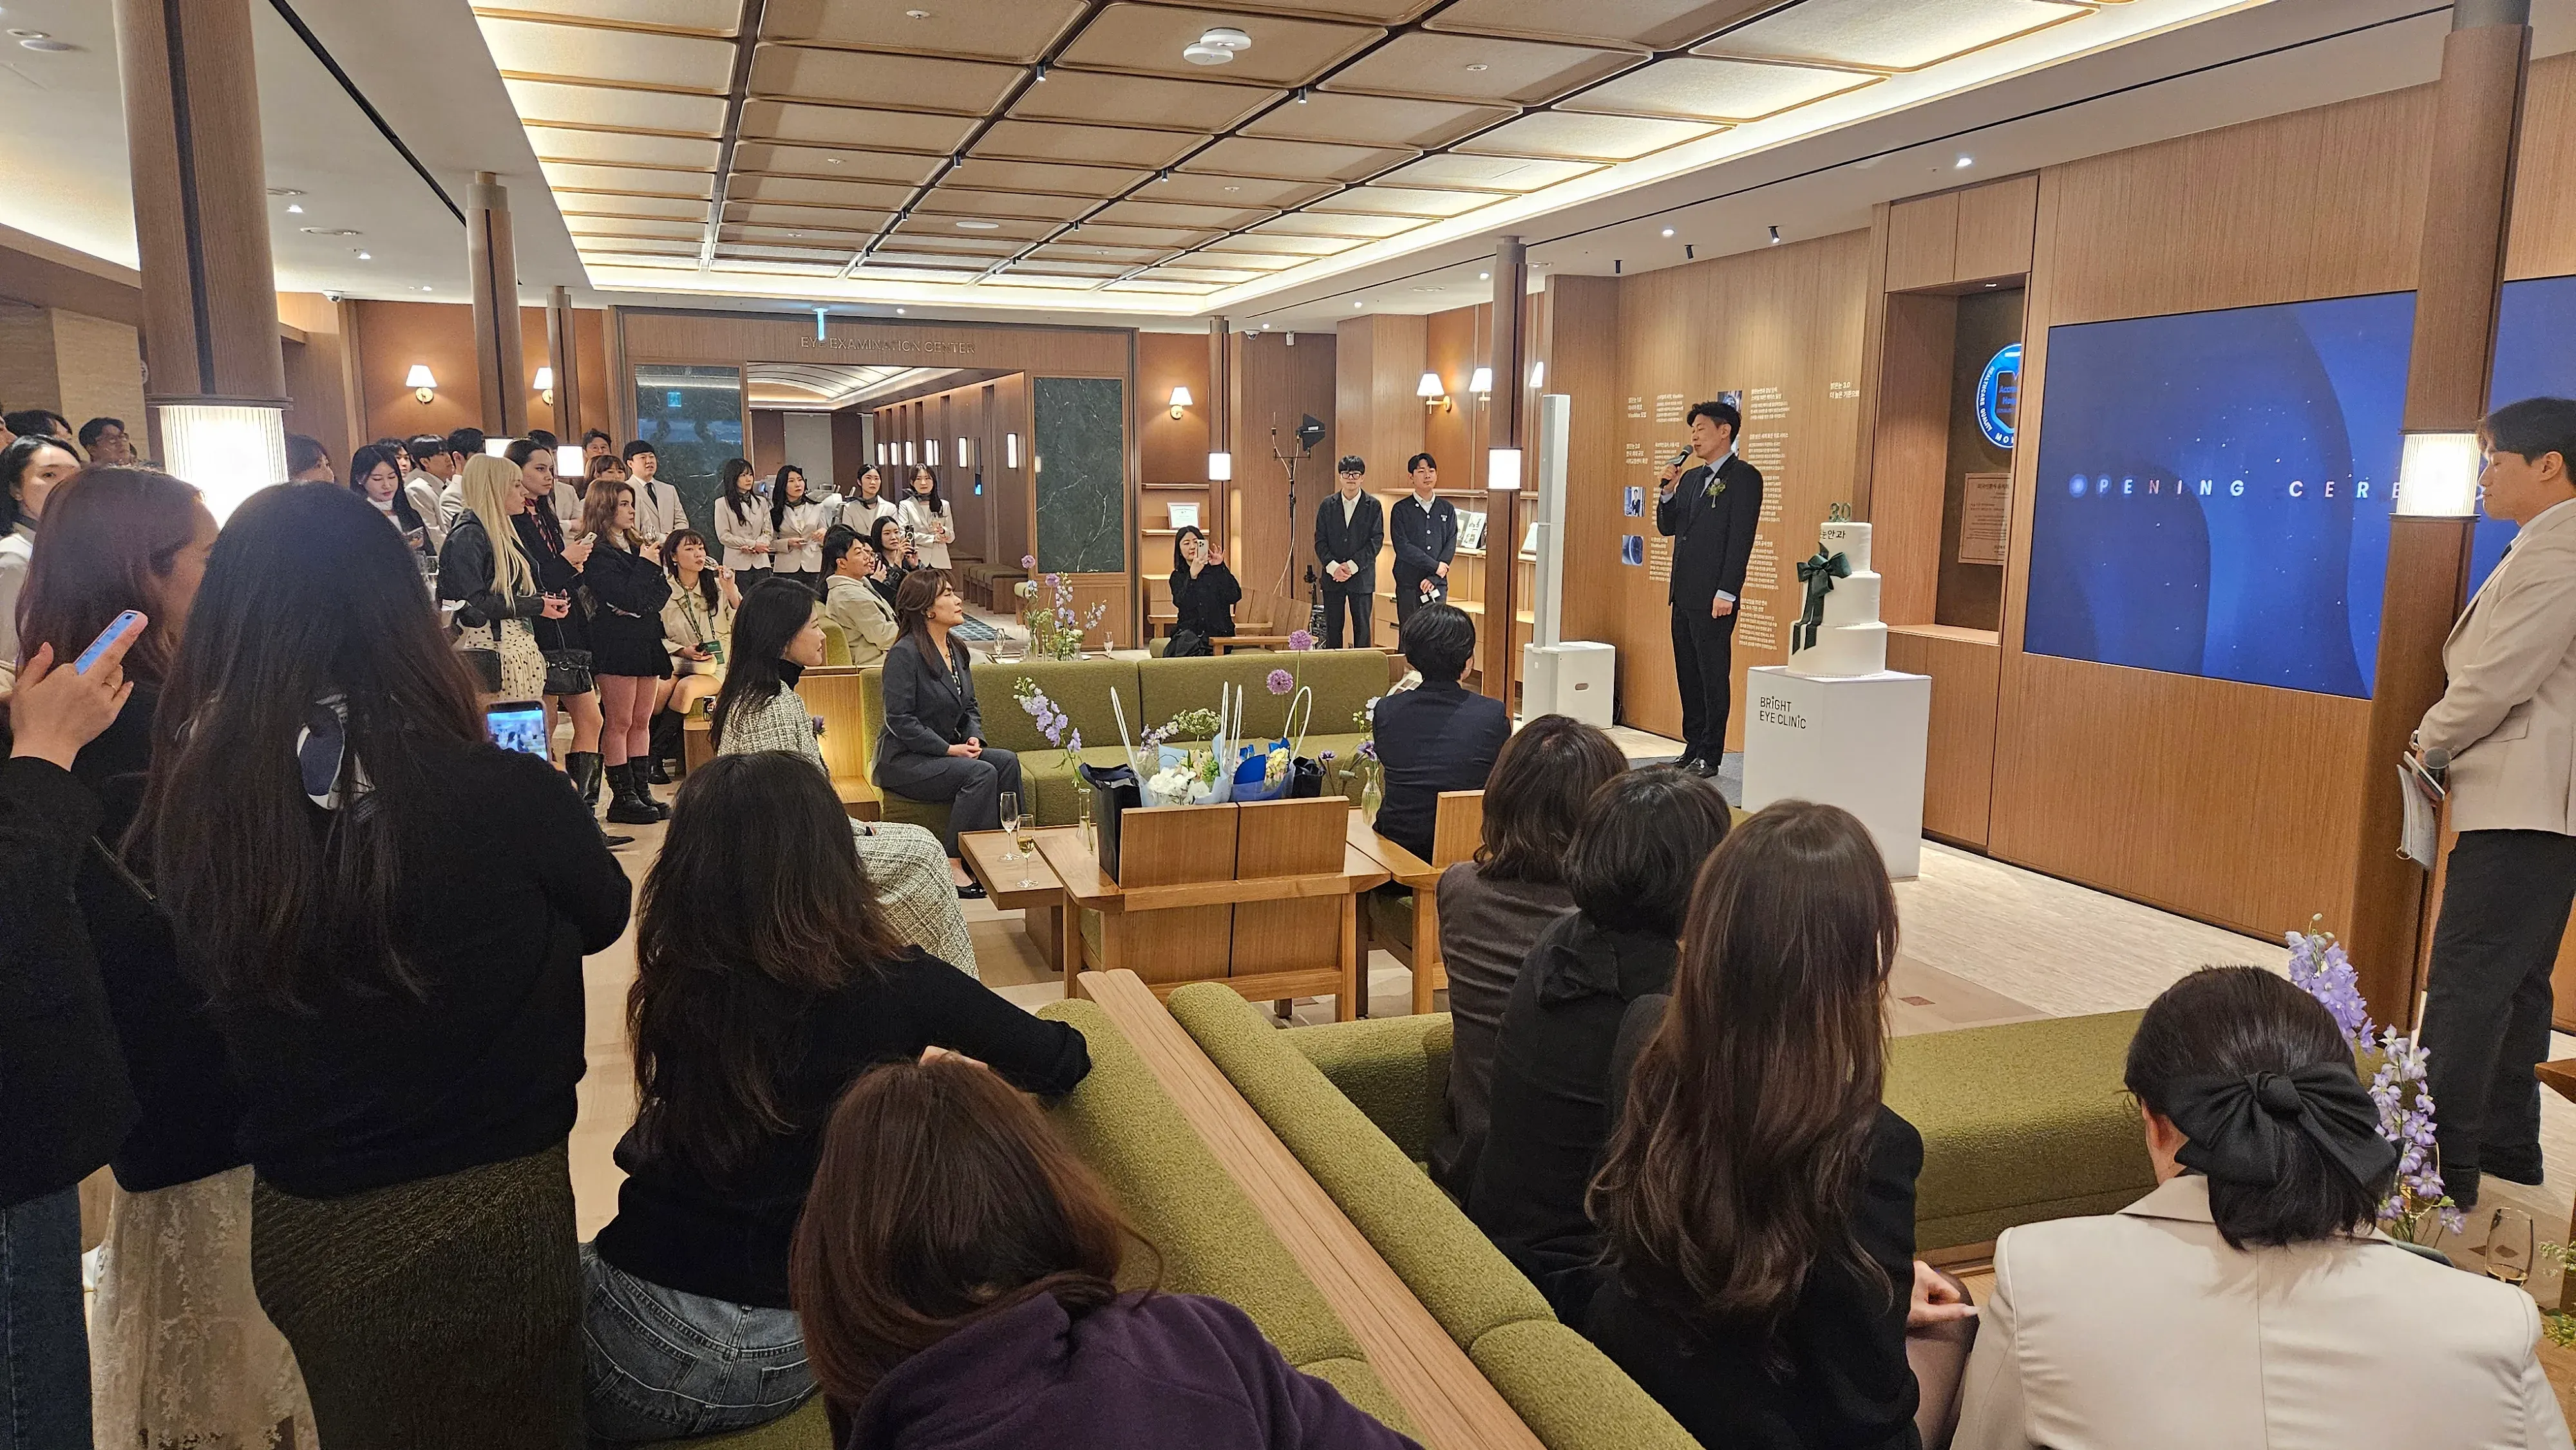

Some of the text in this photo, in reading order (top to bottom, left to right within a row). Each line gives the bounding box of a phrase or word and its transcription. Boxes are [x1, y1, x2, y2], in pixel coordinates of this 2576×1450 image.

[924, 341, 975, 353] CENTER
[1980, 408, 1993, 432] QUALITY
[1760, 710, 1776, 723] EYE
